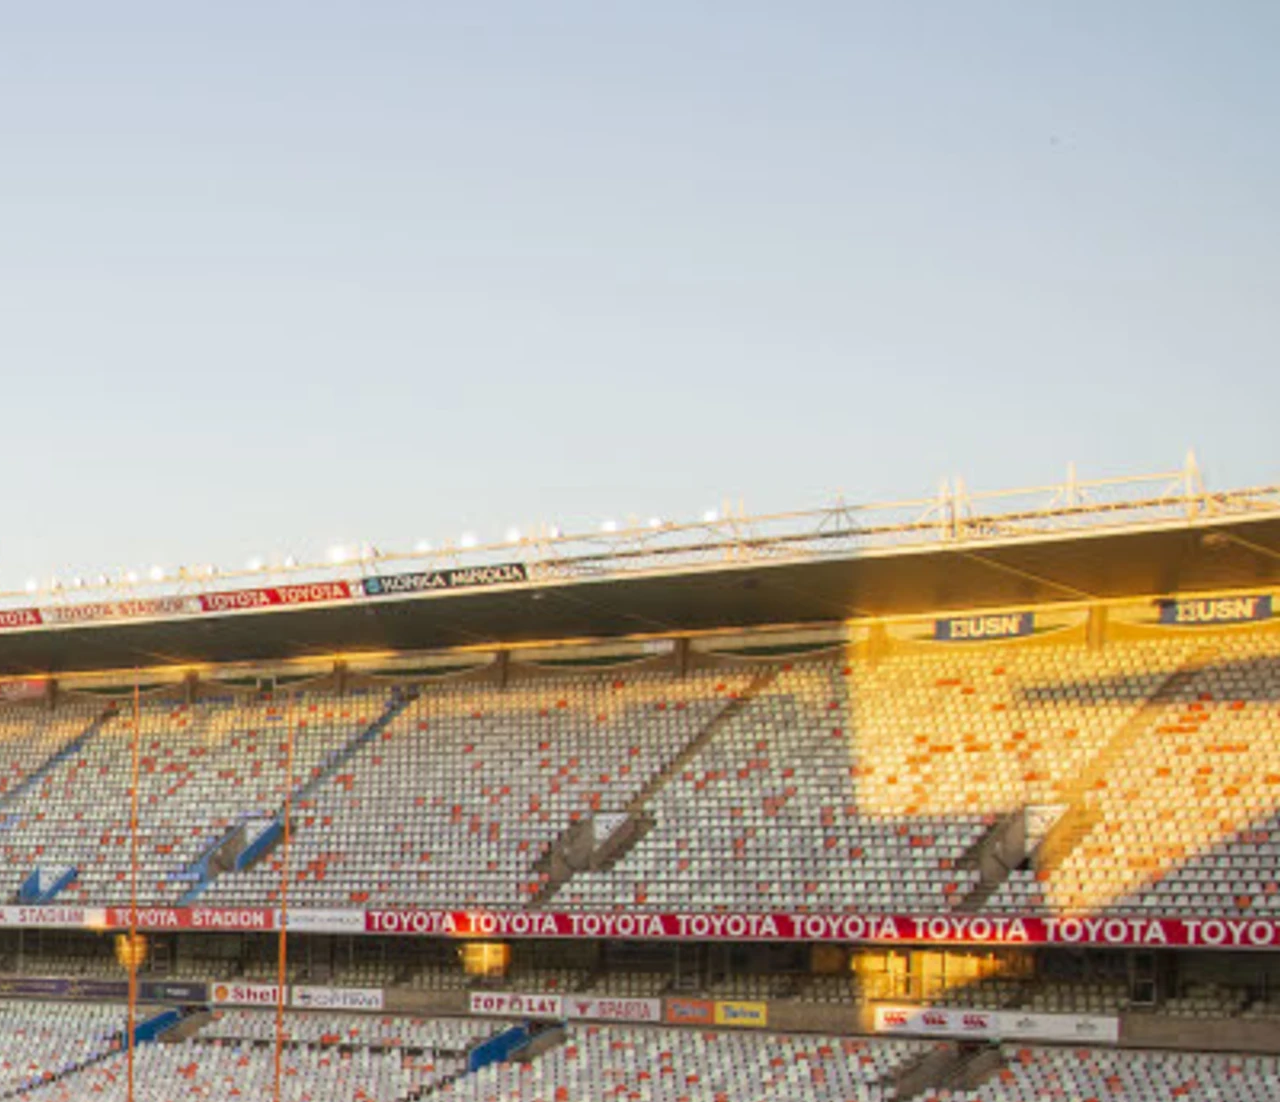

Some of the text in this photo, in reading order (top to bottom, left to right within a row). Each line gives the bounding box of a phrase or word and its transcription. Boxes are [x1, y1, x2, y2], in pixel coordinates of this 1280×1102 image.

[206, 585, 345, 610] TOYOTA TOYOTA
[1197, 598, 1254, 621] USN
[969, 615, 1019, 636] USN
[116, 909, 264, 927] TOYOTA STADION
[370, 911, 457, 932] TOYOTA
[466, 913, 558, 934] TOYOTA
[568, 914, 665, 935] TOYOTA
[676, 915, 778, 937] TOYOTA
[790, 916, 899, 939] TOYOTA
[912, 917, 1028, 941] TOYOTA
[1042, 919, 1166, 944] TOYOTA
[1182, 920, 1280, 946] TOYO
